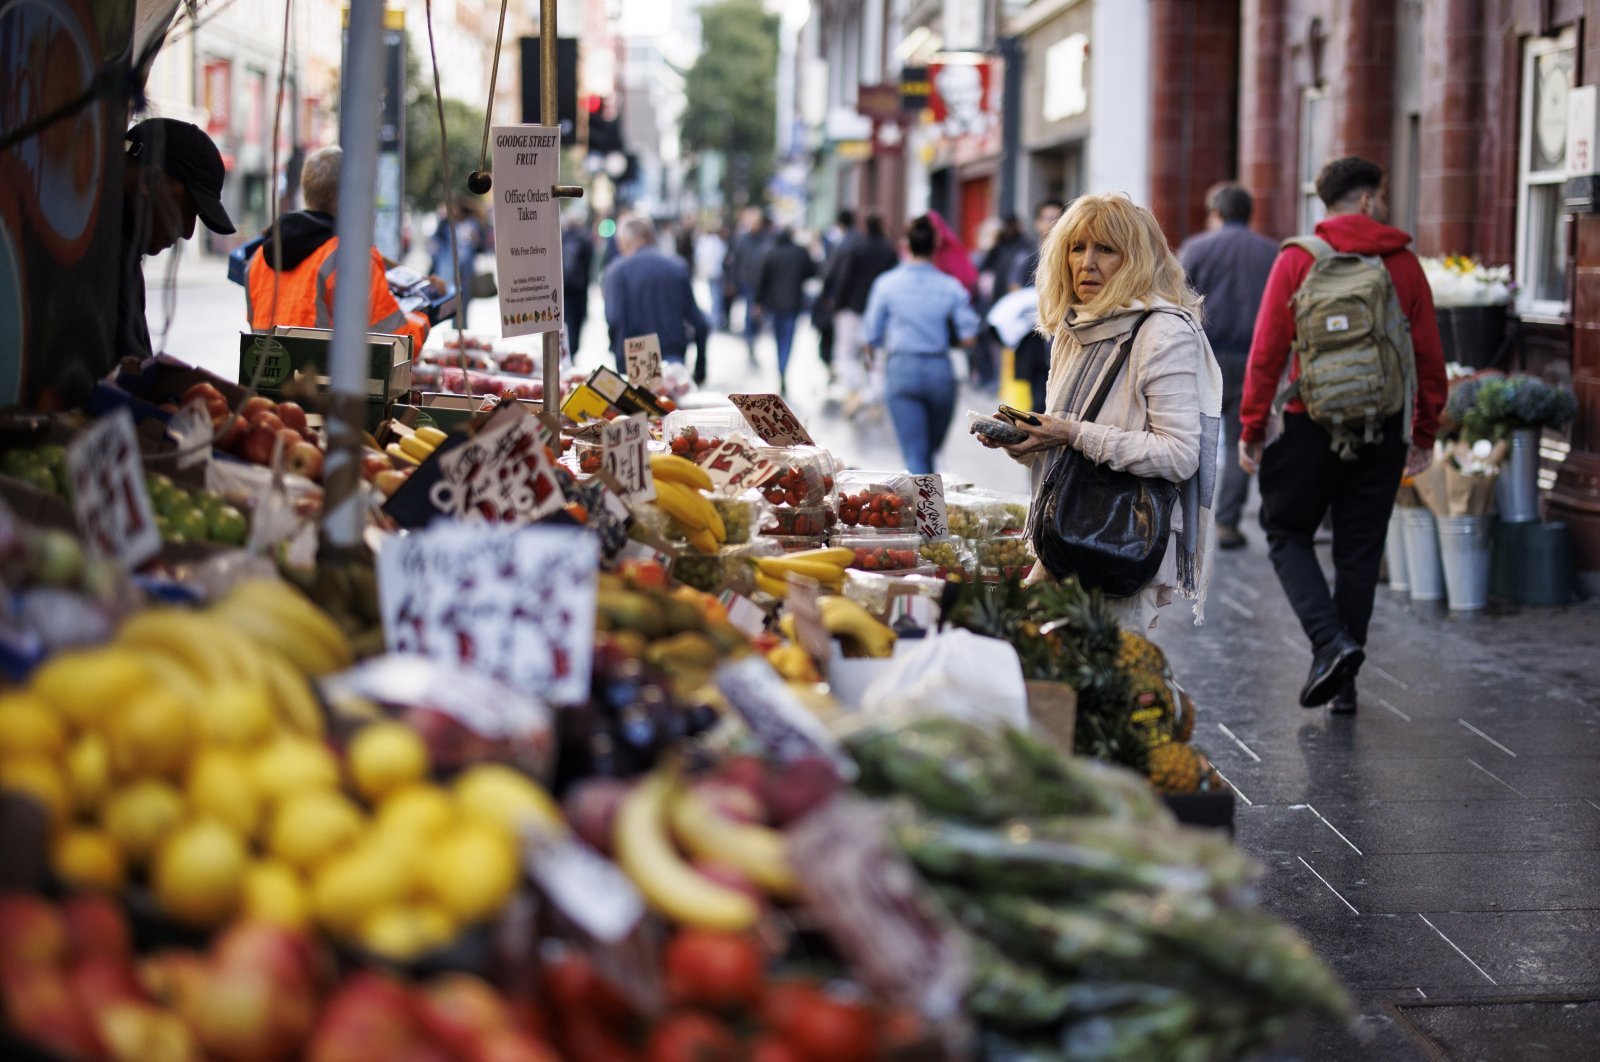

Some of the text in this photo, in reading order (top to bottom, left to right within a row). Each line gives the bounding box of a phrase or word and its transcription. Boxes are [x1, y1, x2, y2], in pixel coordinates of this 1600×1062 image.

[497, 135, 557, 148] GOODGE STREET
[515, 153, 538, 166] FRUIT
[504, 188, 550, 204] Office Orders
[517, 206, 538, 221] Taken
[510, 246, 547, 256] With Free Delivery
[628, 355, 641, 381] 3
[914, 476, 943, 498] BEST
[916, 500, 947, 536] STRAWS
